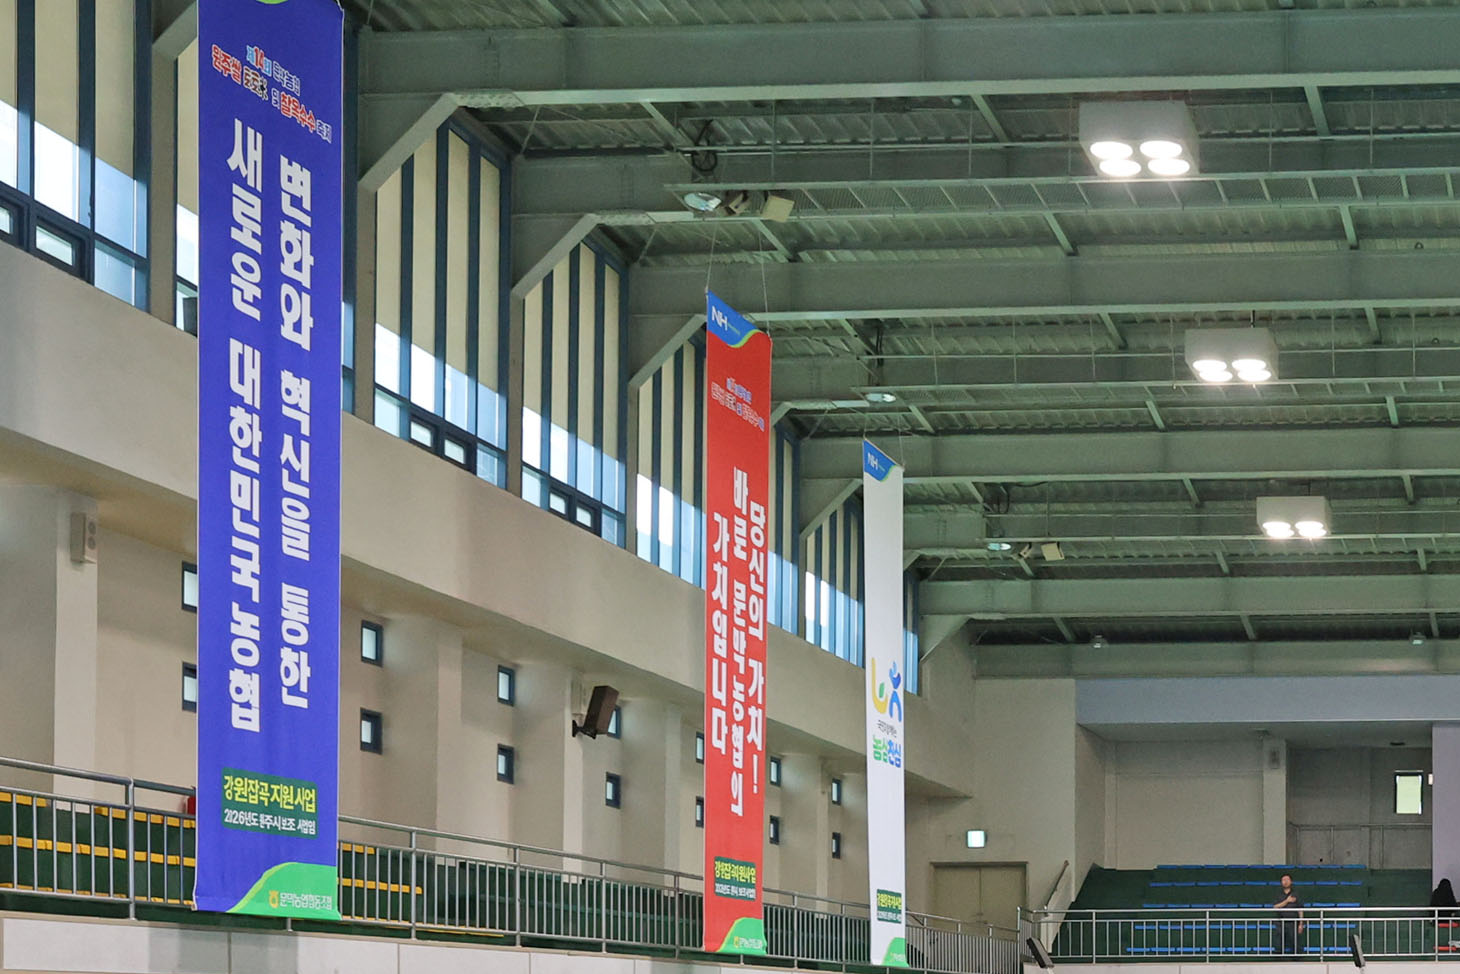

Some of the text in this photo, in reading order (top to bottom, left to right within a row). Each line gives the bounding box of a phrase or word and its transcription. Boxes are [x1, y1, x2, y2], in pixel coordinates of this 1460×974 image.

[226, 118, 263, 321] 새로운
[711, 305, 728, 331] NH
[279, 154, 314, 709] 변화와 혁신을 통한
[733, 466, 748, 561] 바로
[748, 500, 765, 641] 당신의
[711, 512, 730, 756] 가치입니다
[223, 775, 270, 807] 강원잡곡
[747, 658, 765, 794] 가치!
